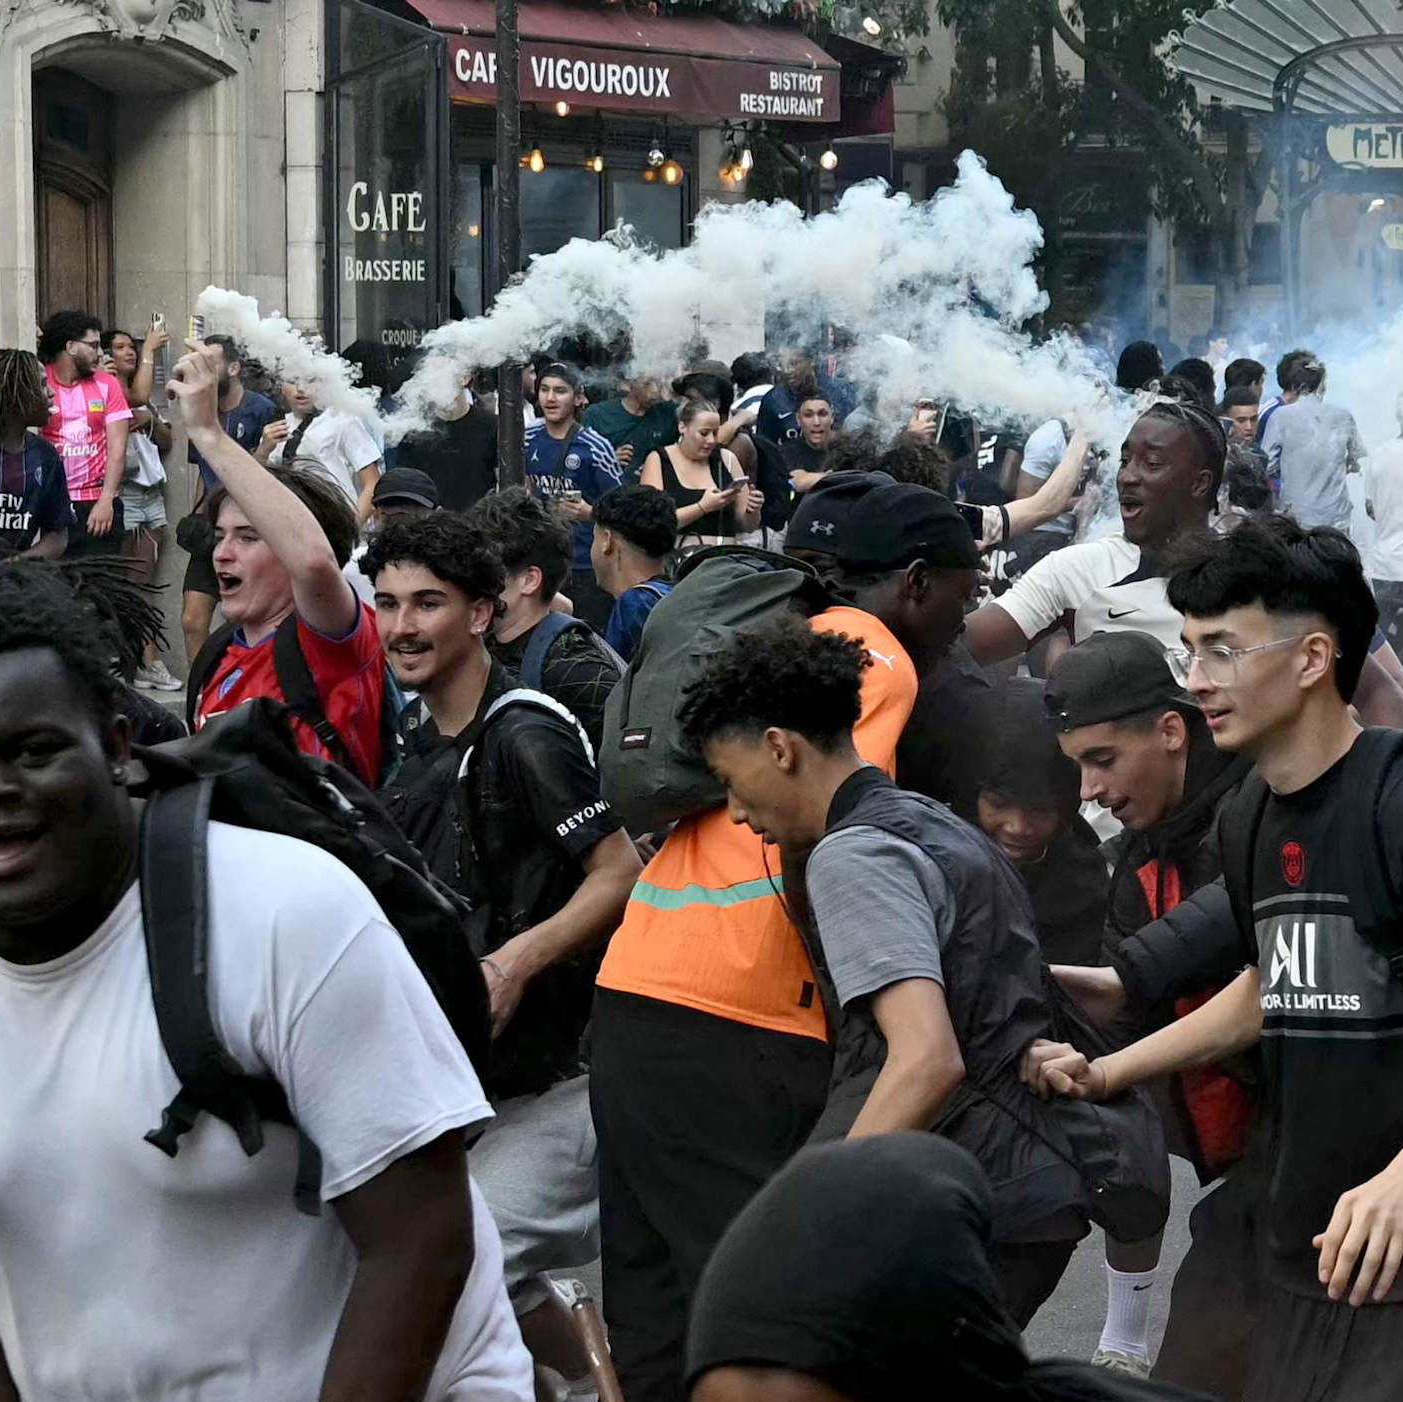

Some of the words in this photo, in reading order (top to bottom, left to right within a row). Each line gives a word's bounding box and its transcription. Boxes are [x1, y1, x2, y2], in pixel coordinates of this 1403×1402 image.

[530, 56, 671, 98] VIGOUROUX
[769, 71, 823, 95] BISTROT
[740, 93, 823, 117] RESTAURANT
[345, 256, 426, 281] BRASSERIE
[55, 438, 99, 458] Chang
[556, 800, 612, 837] BEYON
[1294, 994, 1361, 1012] LIMITLESS
